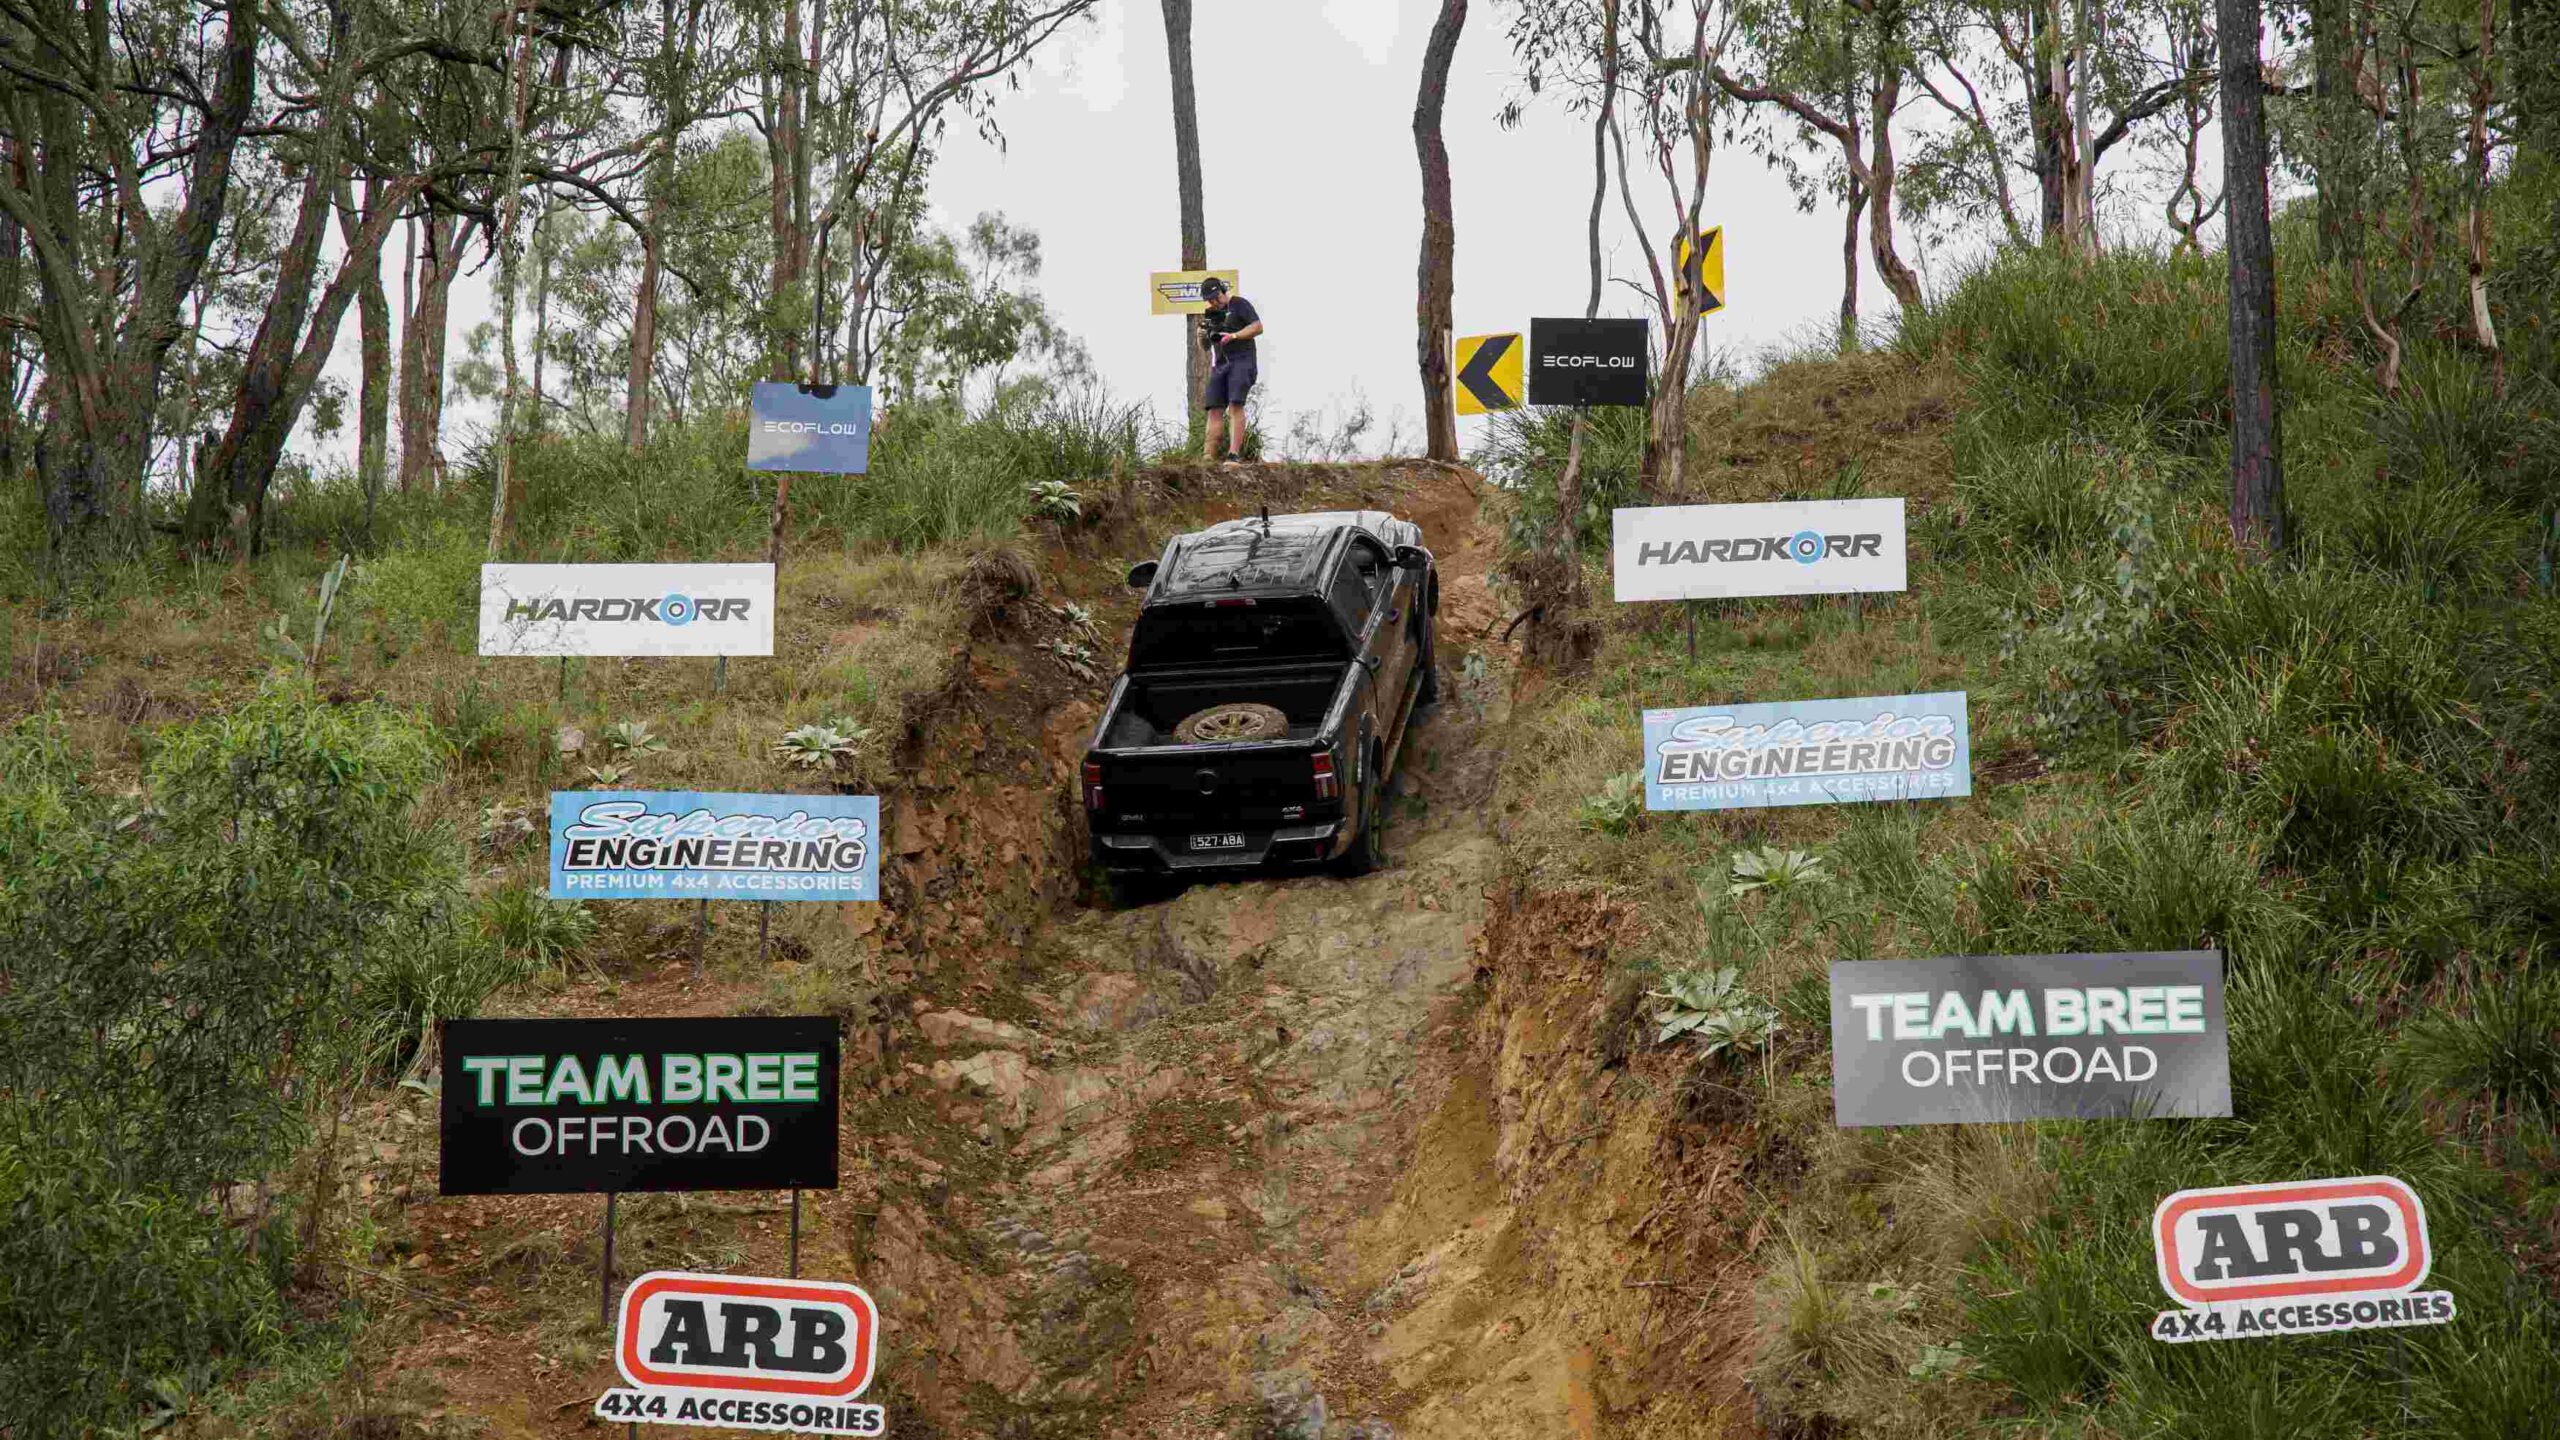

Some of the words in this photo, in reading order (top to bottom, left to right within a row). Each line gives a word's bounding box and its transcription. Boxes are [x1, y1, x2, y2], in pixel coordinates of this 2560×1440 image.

[1543, 355, 1635, 368] ECOFLOW
[763, 421, 857, 435] ECOFLOW
[1637, 530, 1882, 566] HARDKORR
[505, 593, 751, 626] HARDKORR
[1656, 712, 1956, 751] Superior
[1662, 737, 1952, 781] ENGINEERING
[1661, 783, 1756, 801] PREMIUM
[1765, 780, 1800, 797] 4x4
[564, 800, 867, 843] Superior
[567, 839, 864, 868] ENGINEERING
[566, 873, 664, 889] PREMIUM
[671, 873, 709, 889] 4x4
[717, 874, 864, 890] ACCESSORIES
[1850, 988, 2037, 1041] TEAM
[2043, 984, 2206, 1036] BREE
[463, 1054, 652, 1106] TEAM
[661, 1052, 820, 1105] BREE
[1900, 1045, 2159, 1088] OFFROAD
[512, 1115, 771, 1156] OFFROAD
[2194, 1204, 2399, 1281] ARB
[649, 1298, 847, 1374] ARB
[2158, 1311, 2226, 1337] 4X4
[2236, 1295, 2452, 1333] ACCESSORIES
[600, 1393, 668, 1418] 4X4
[676, 1397, 881, 1432] ACCESSORIES
